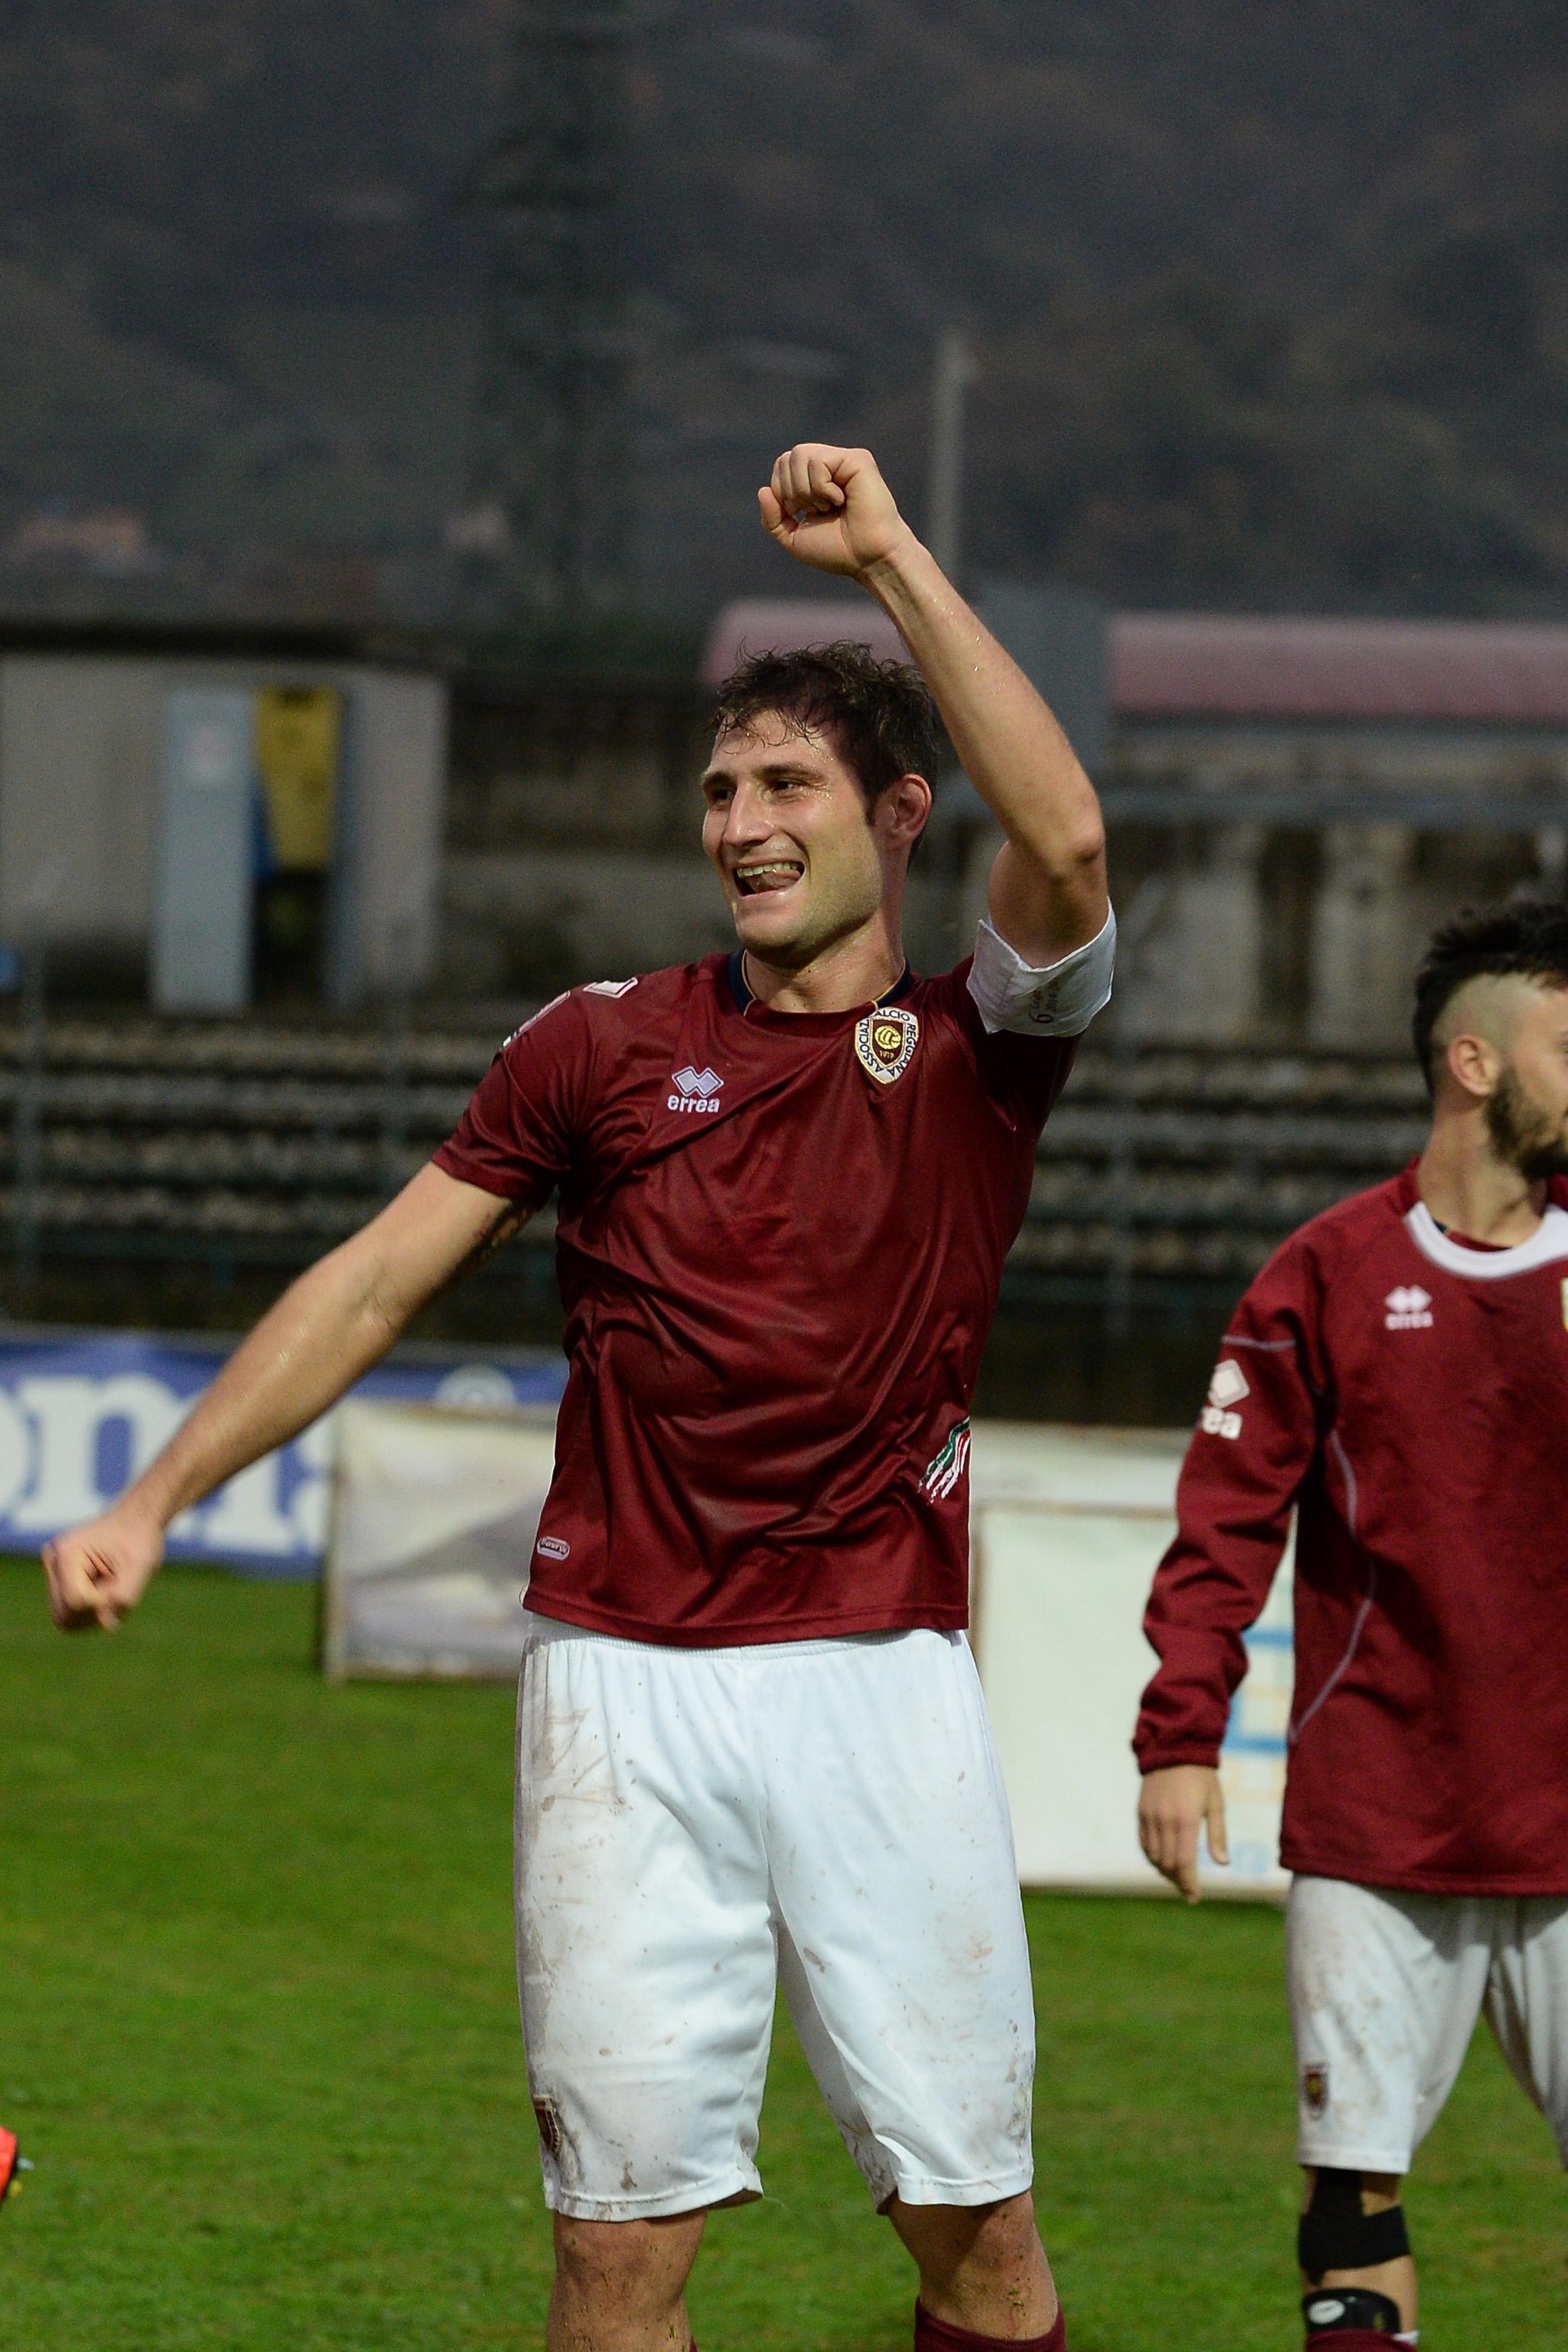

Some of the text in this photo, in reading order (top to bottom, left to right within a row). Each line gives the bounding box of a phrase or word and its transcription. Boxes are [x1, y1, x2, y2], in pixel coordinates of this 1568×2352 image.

[873, 1010, 911, 1022] ALCIO
[886, 1023, 916, 1077] REGGIANA
[667, 1095, 720, 1113] errea
